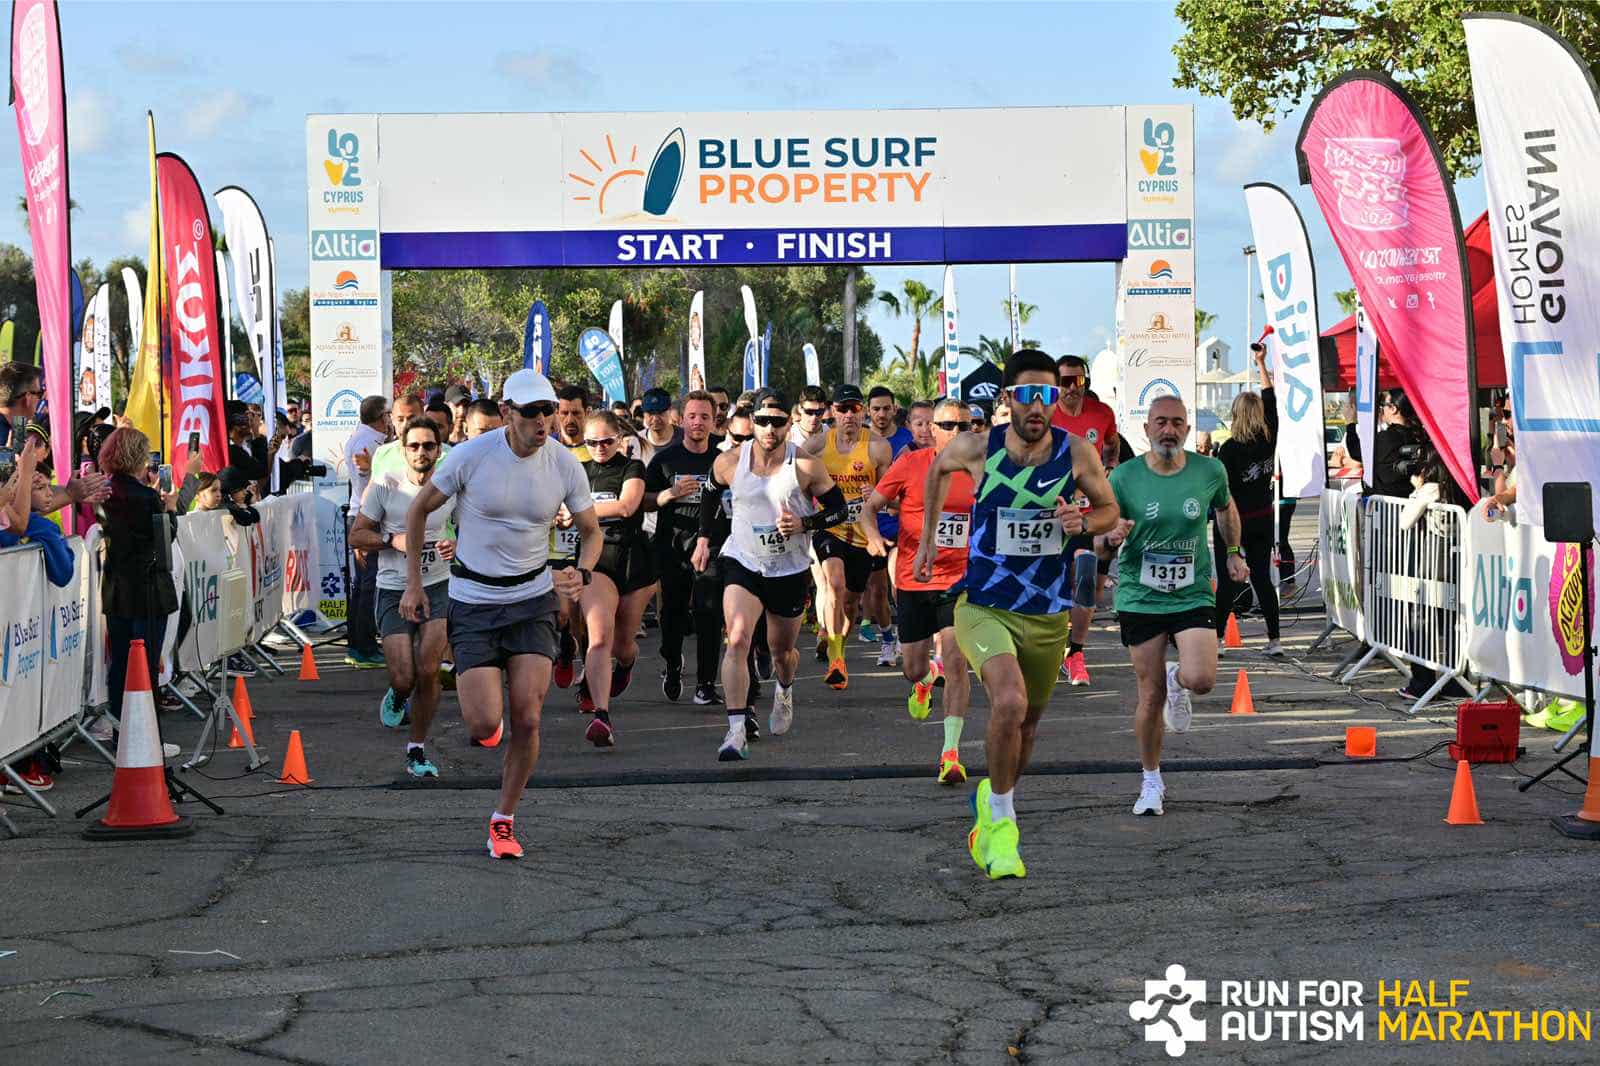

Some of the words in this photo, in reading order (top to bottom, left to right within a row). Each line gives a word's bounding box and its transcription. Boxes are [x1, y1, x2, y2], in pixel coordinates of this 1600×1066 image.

[699, 138, 810, 169] BLUE
[824, 137, 937, 168] SURF
[699, 172, 931, 204] PROPERTY
[1138, 180, 1179, 193] CYPRUS
[323, 191, 364, 204] CYPRUS
[1128, 222, 1190, 247] Altia
[314, 233, 376, 257] Altia
[617, 234, 723, 261] START
[777, 232, 892, 259] FINISH
[938, 522, 963, 535] 218
[1007, 522, 1054, 539] 1549
[1150, 565, 1187, 580] 1313
[1472, 553, 1533, 634] Altia
[320, 601, 345, 609] HALF
